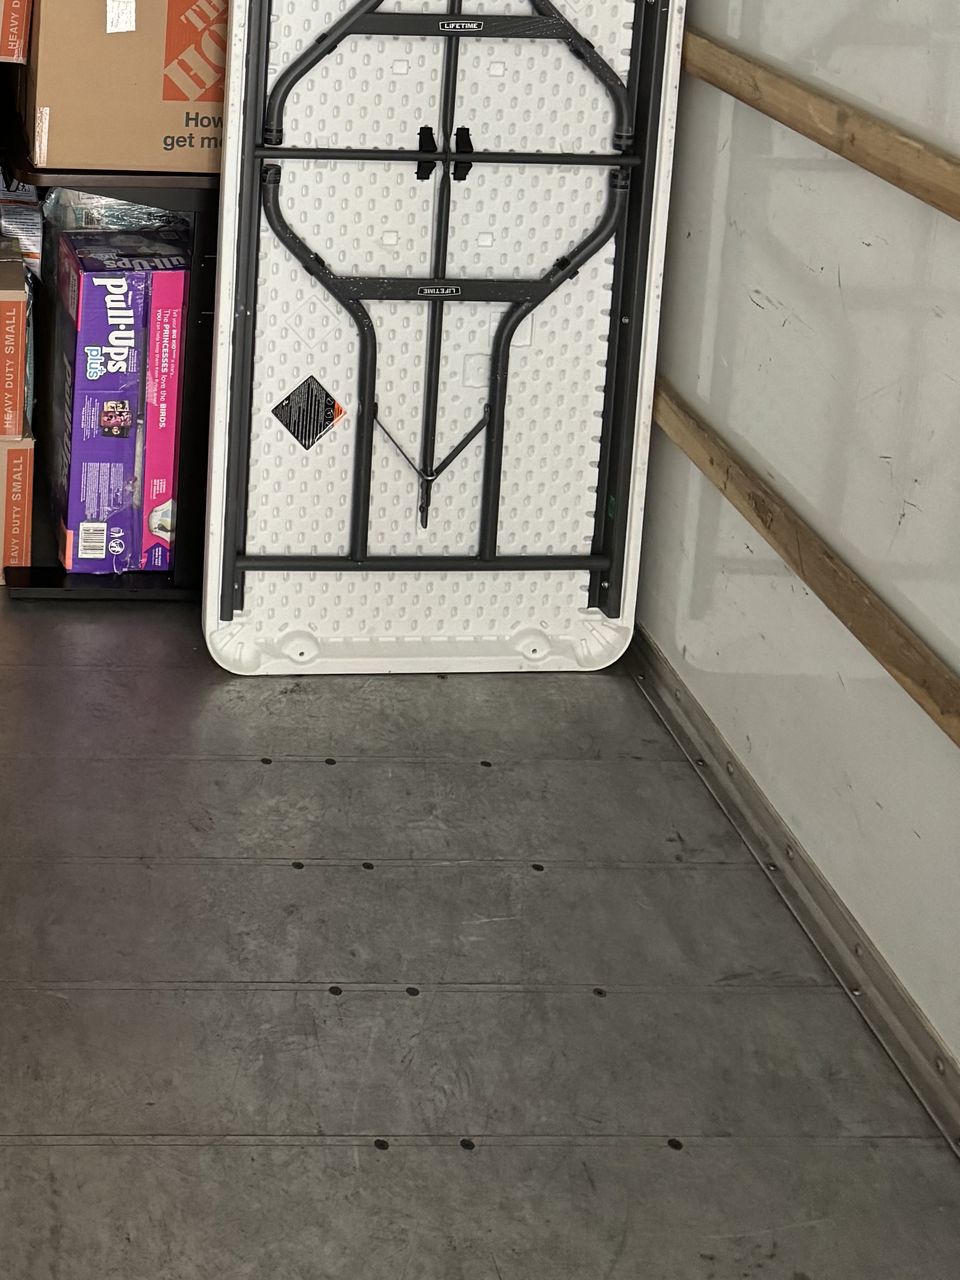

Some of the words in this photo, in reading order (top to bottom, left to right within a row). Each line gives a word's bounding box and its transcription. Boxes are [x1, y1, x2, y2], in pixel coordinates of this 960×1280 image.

[8, 13, 19, 50] HEAVY
[163, 134, 194, 151] get
[5, 308, 16, 355] SMALL
[161, 324, 169, 373] PRINCESSES
[5, 359, 14, 389] DUTY
[4, 393, 13, 428] HEAVY
[159, 404, 167, 429] BIRDS.
[12, 456, 22, 501] SMALL
[12, 506, 21, 534] DUTY
[10, 538, 19, 566] EAVY
